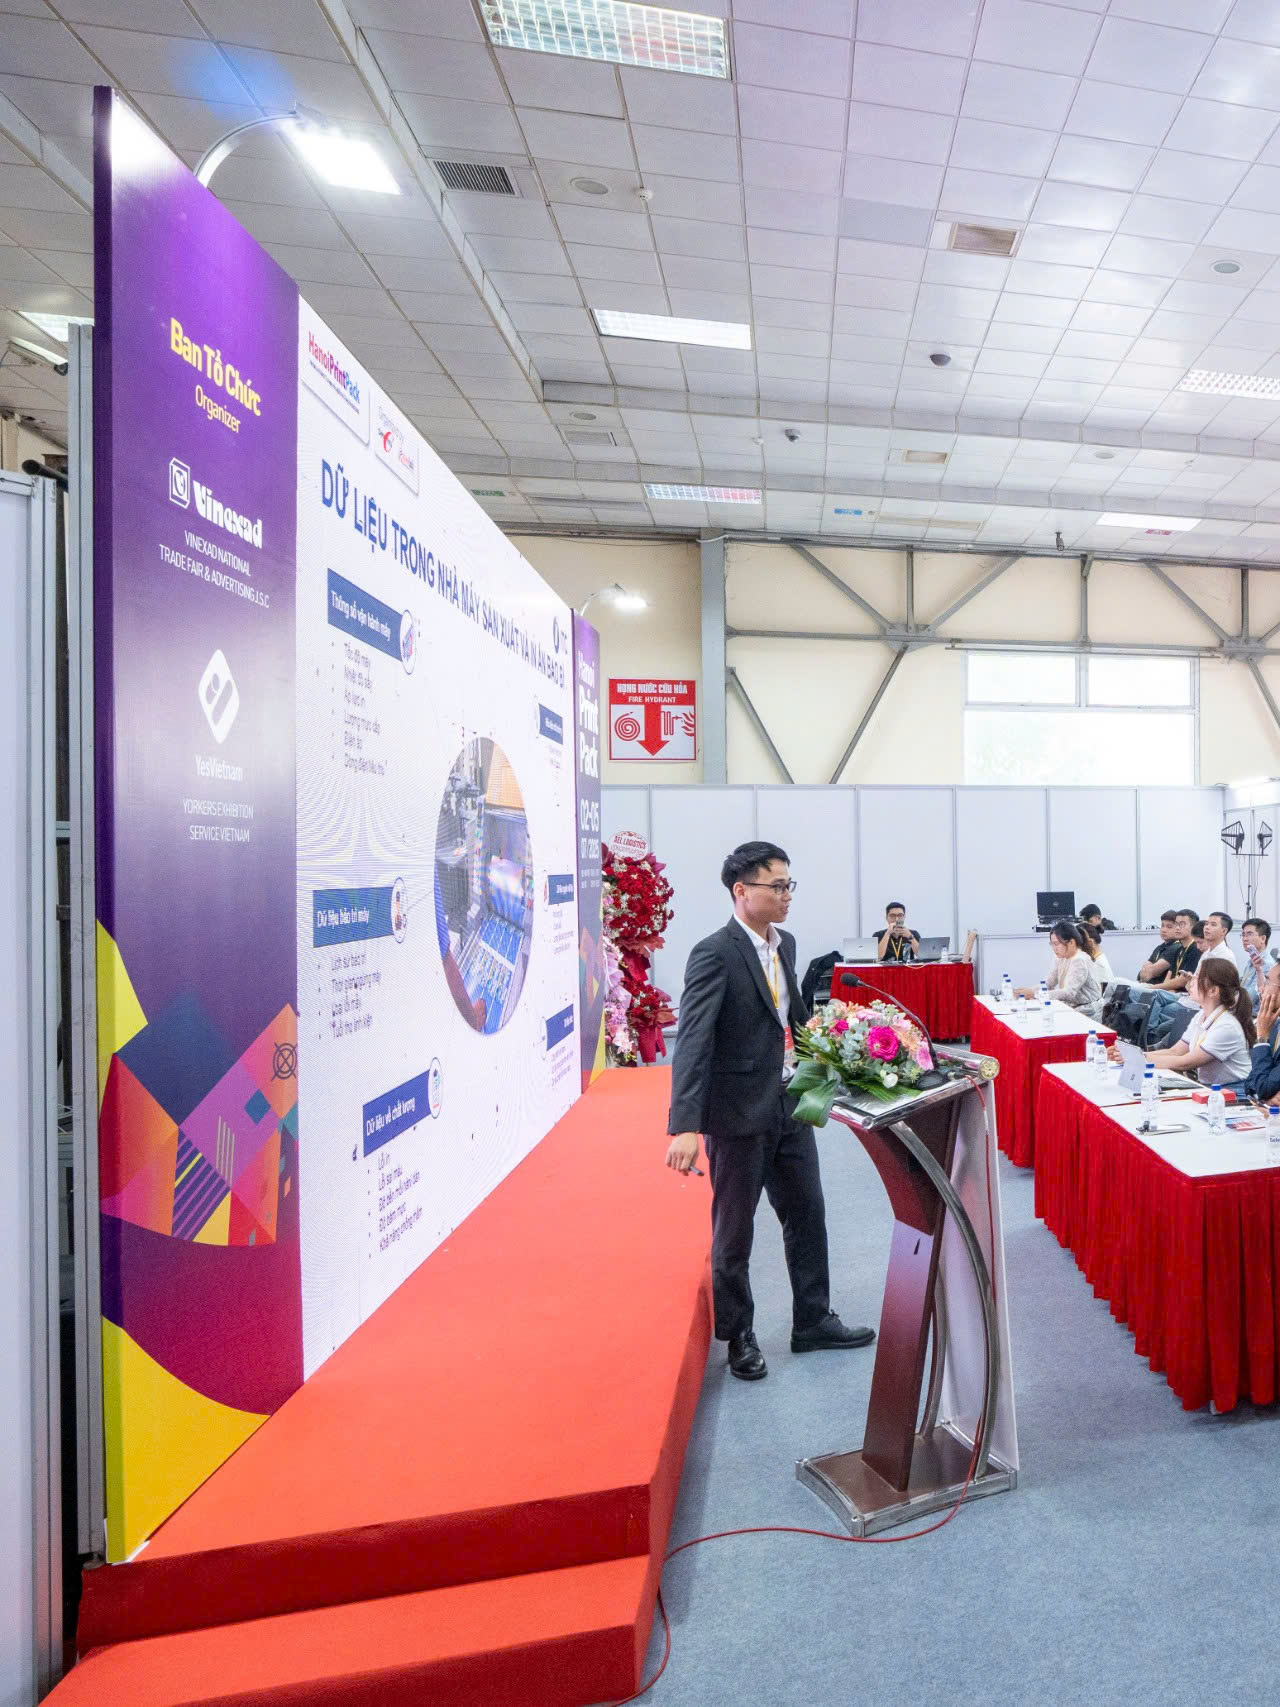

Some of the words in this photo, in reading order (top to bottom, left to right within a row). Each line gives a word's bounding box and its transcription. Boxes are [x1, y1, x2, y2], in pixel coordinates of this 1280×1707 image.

[170, 317, 202, 371] Ban
[203, 344, 224, 387] Tổ
[225, 363, 261, 416] Chức
[195, 384, 241, 433] Organizer
[193, 480, 263, 549] Vinexad
[184, 530, 217, 560] VINEXAD
[218, 547, 251, 576] NATIONAL
[321, 458, 349, 518] DỮ
[354, 487, 387, 553] LIỆU
[391, 519, 435, 588] TRONG
[438, 559, 459, 608] NHÀ
[461, 581, 480, 624] MÁY
[159, 544, 186, 571] TRADE
[187, 557, 203, 580] FAIR
[204, 565, 211, 582] &
[211, 569, 255, 602] ADVERTISING
[579, 685, 599, 735] Print
[195, 754, 243, 782] YesVietnam
[579, 732, 599, 778] Pack
[183, 799, 217, 816] YORKERS
[218, 801, 254, 819] EXHIBITION
[580, 799, 600, 832] 02-05
[189, 825, 219, 840] SERVICE
[219, 826, 250, 842] VIETNAM
